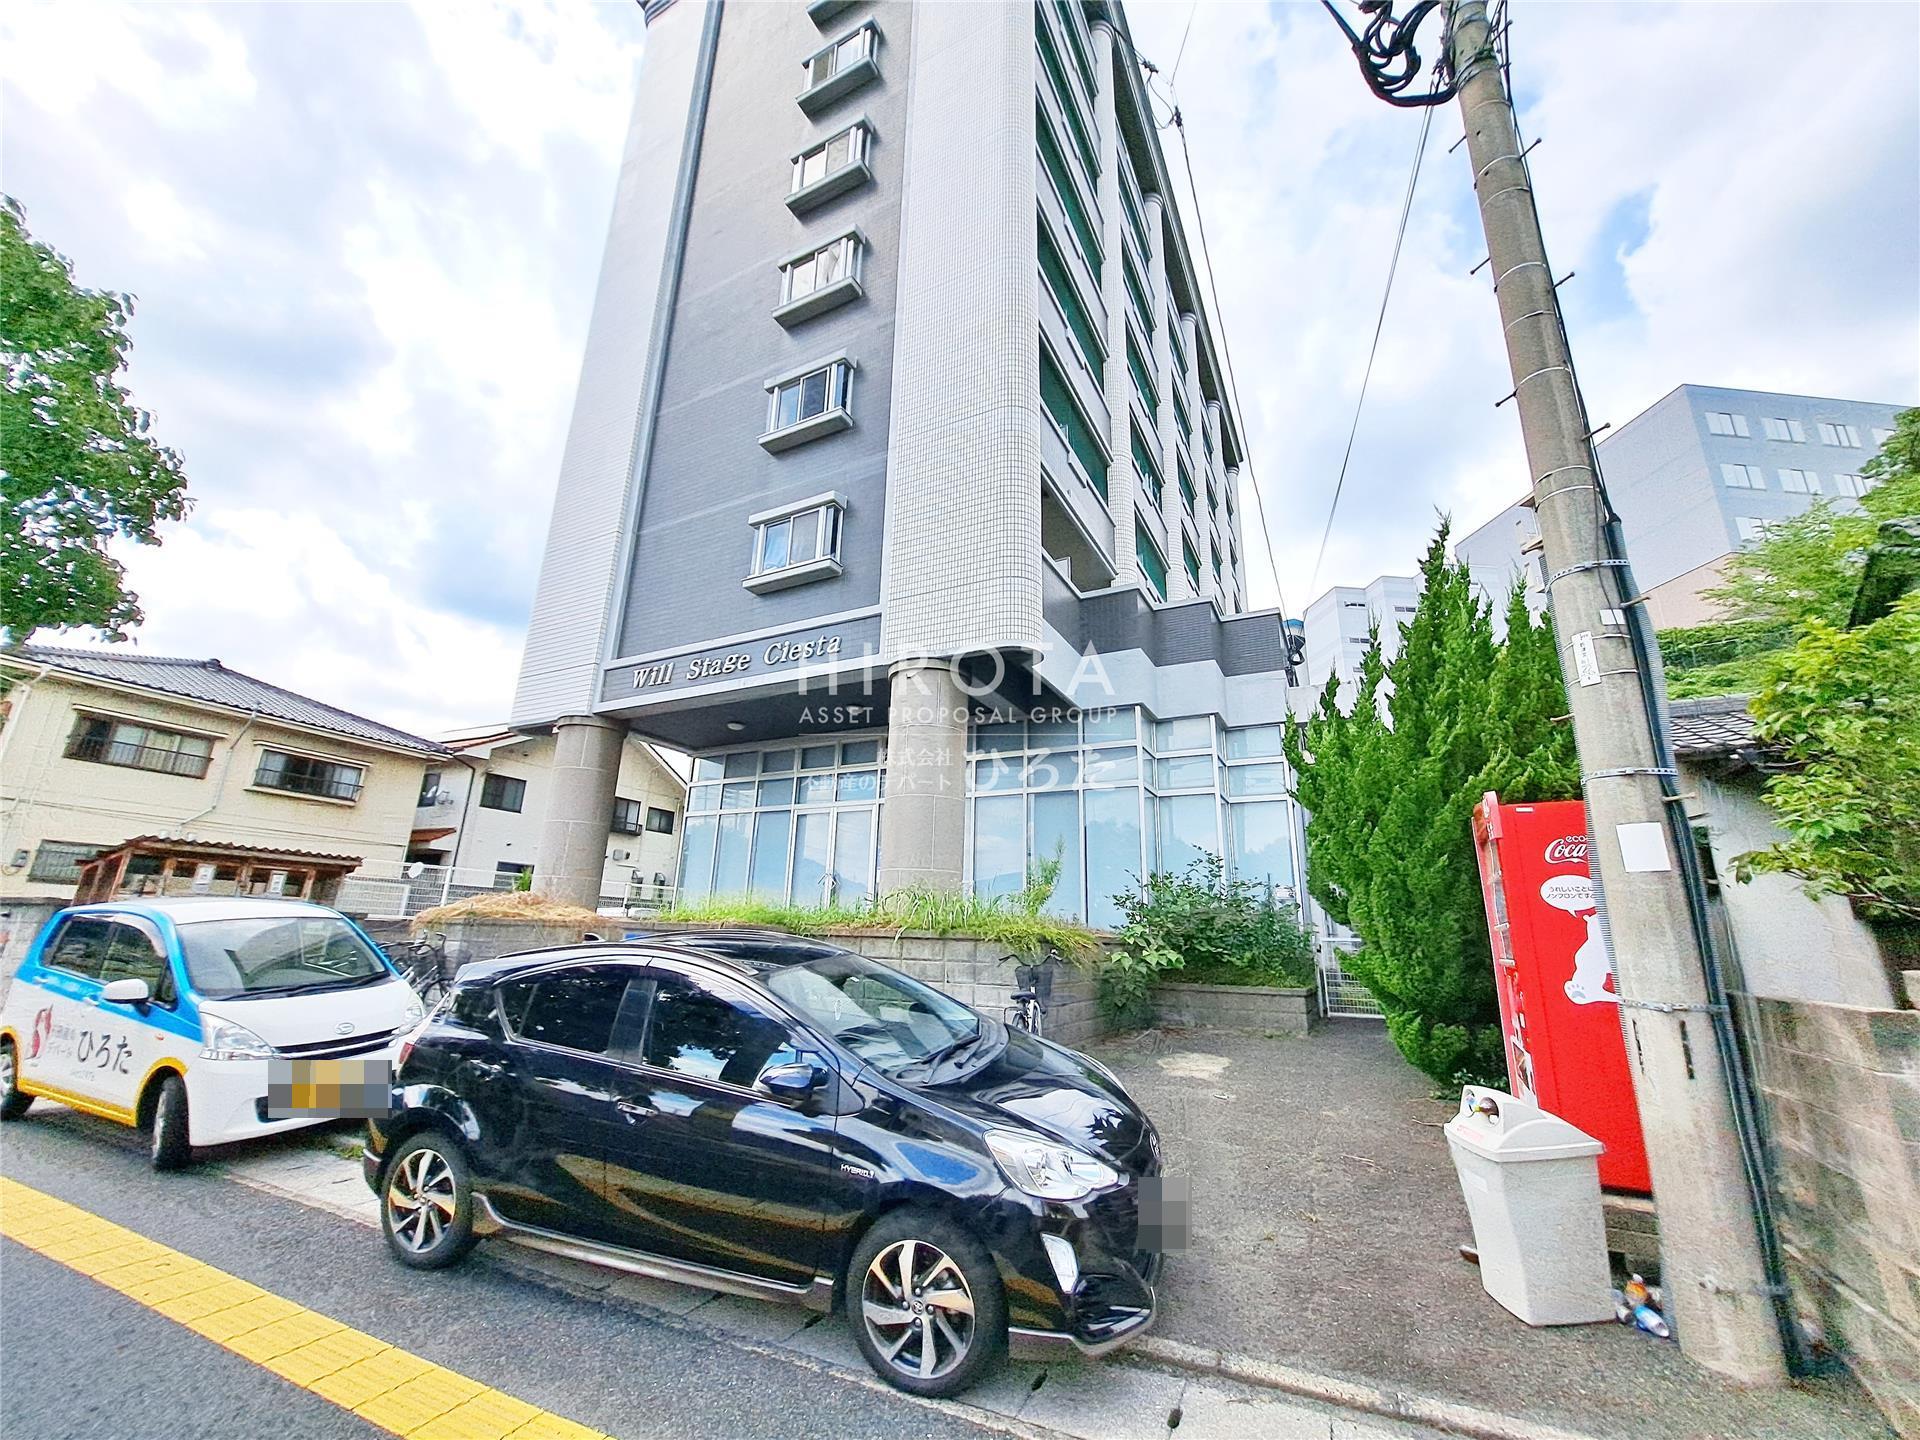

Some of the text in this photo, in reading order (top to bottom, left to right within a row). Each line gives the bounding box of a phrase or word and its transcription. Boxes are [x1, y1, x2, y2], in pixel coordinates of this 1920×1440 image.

[632, 634, 843, 688] Will Stage Ciesta
[78, 1030, 133, 1075] ひろた
